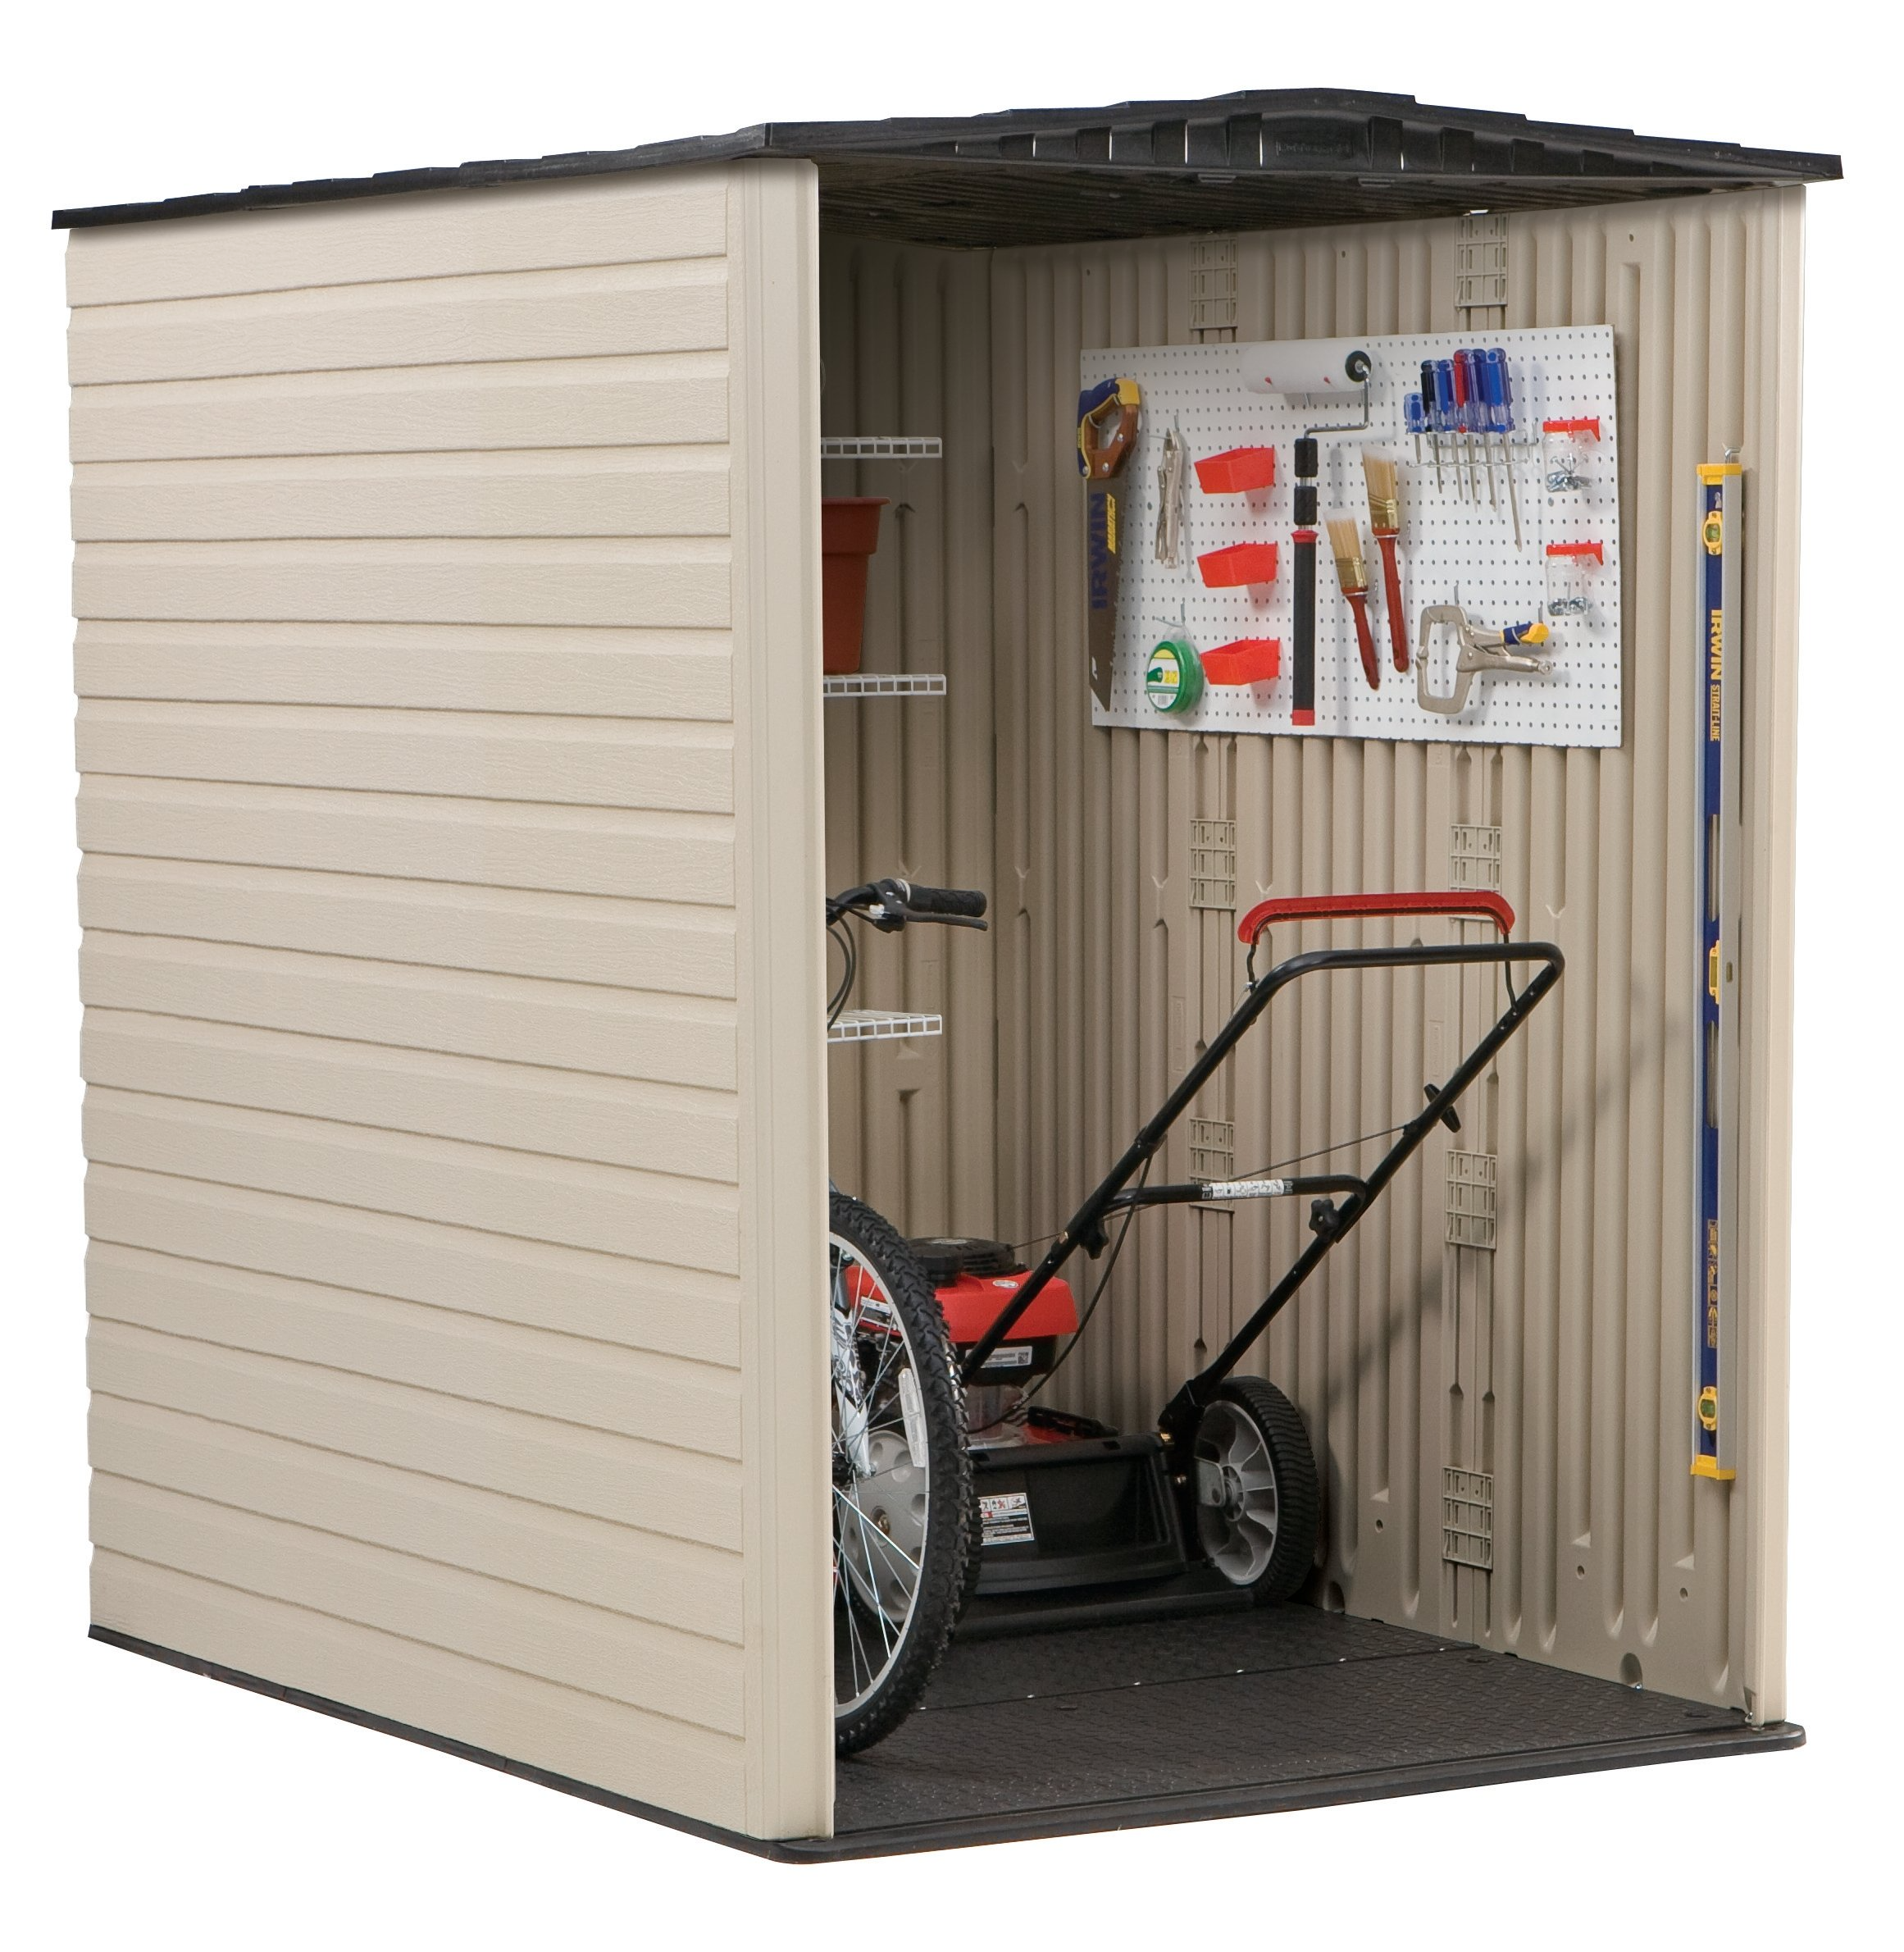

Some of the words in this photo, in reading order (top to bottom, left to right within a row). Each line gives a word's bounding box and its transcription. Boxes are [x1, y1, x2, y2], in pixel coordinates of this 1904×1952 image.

[1089, 493, 1107, 609] IRWIN
[1710, 609, 1722, 681] IRWIN
[1710, 684, 1720, 741] STRAIT-LINE
